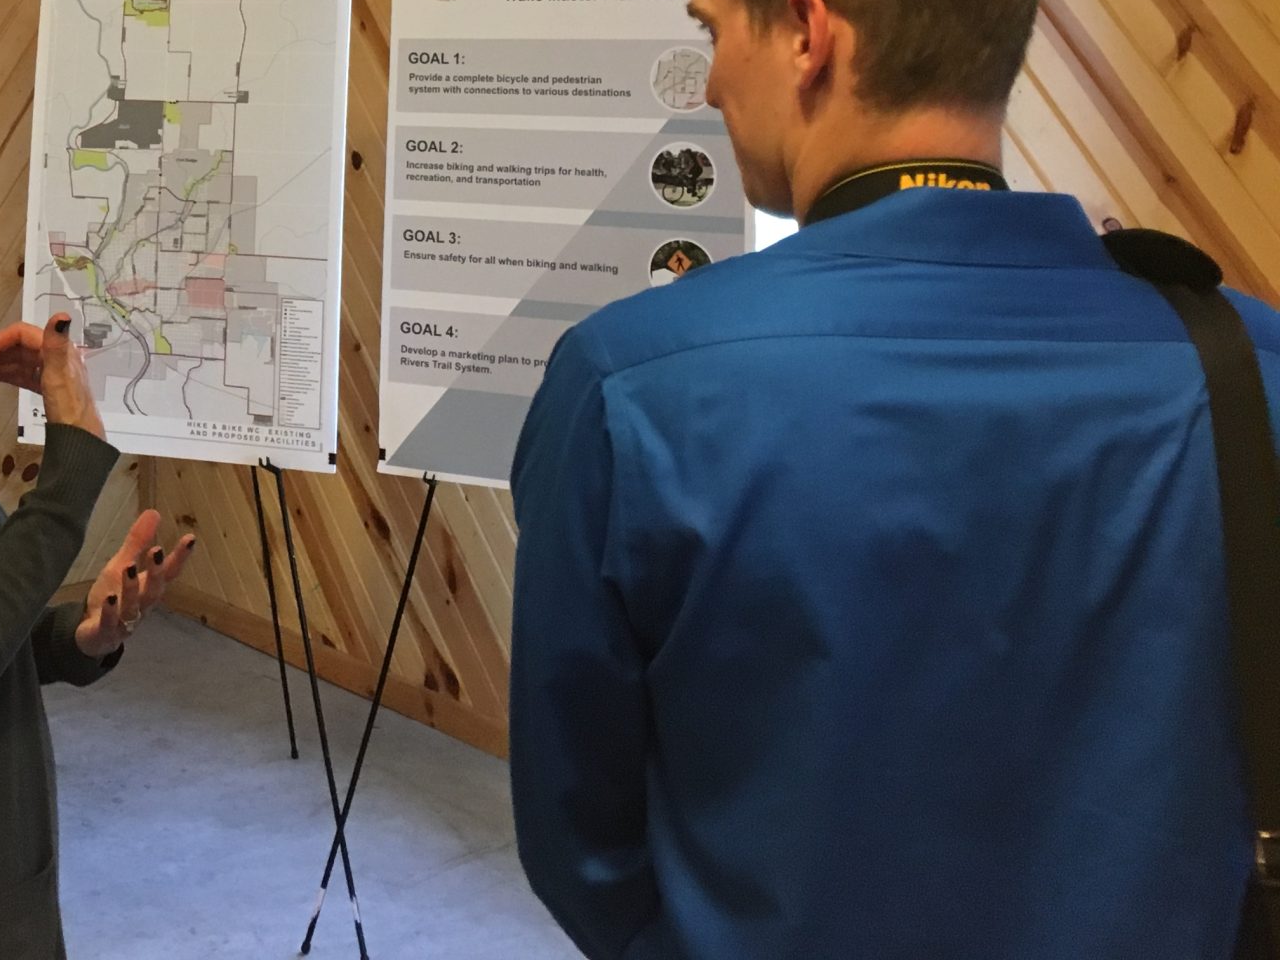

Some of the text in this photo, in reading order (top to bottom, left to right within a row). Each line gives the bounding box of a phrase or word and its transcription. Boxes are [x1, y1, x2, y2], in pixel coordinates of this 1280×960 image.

[408, 52, 465, 65] GOAL 1:
[408, 72, 602, 85] Provide a complete bicycle and pedestrian
[408, 86, 631, 97] system with connections to various destinations
[406, 140, 463, 154] GOAL 2:
[406, 161, 607, 178] Increase biking and walking trips for health,
[406, 173, 541, 187] recreation, and transportation
[900, 173, 992, 191] Nikon
[403, 229, 461, 245] GOAL 3:
[403, 250, 619, 275] Ensure safety for all when biking and walking
[400, 321, 458, 338] GOAL 4:
[400, 344, 438, 357] Develop
[448, 350, 496, 364] marketing
[498, 354, 519, 364] plan
[521, 356, 531, 365] to
[400, 357, 493, 374] Rivers Trail System.
[187, 421, 208, 429] HIKE
[221, 424, 242, 432] BIKE
[268, 429, 312, 438] EXISTING
[190, 429, 317, 447] AND PROPOSED FACILITIES
